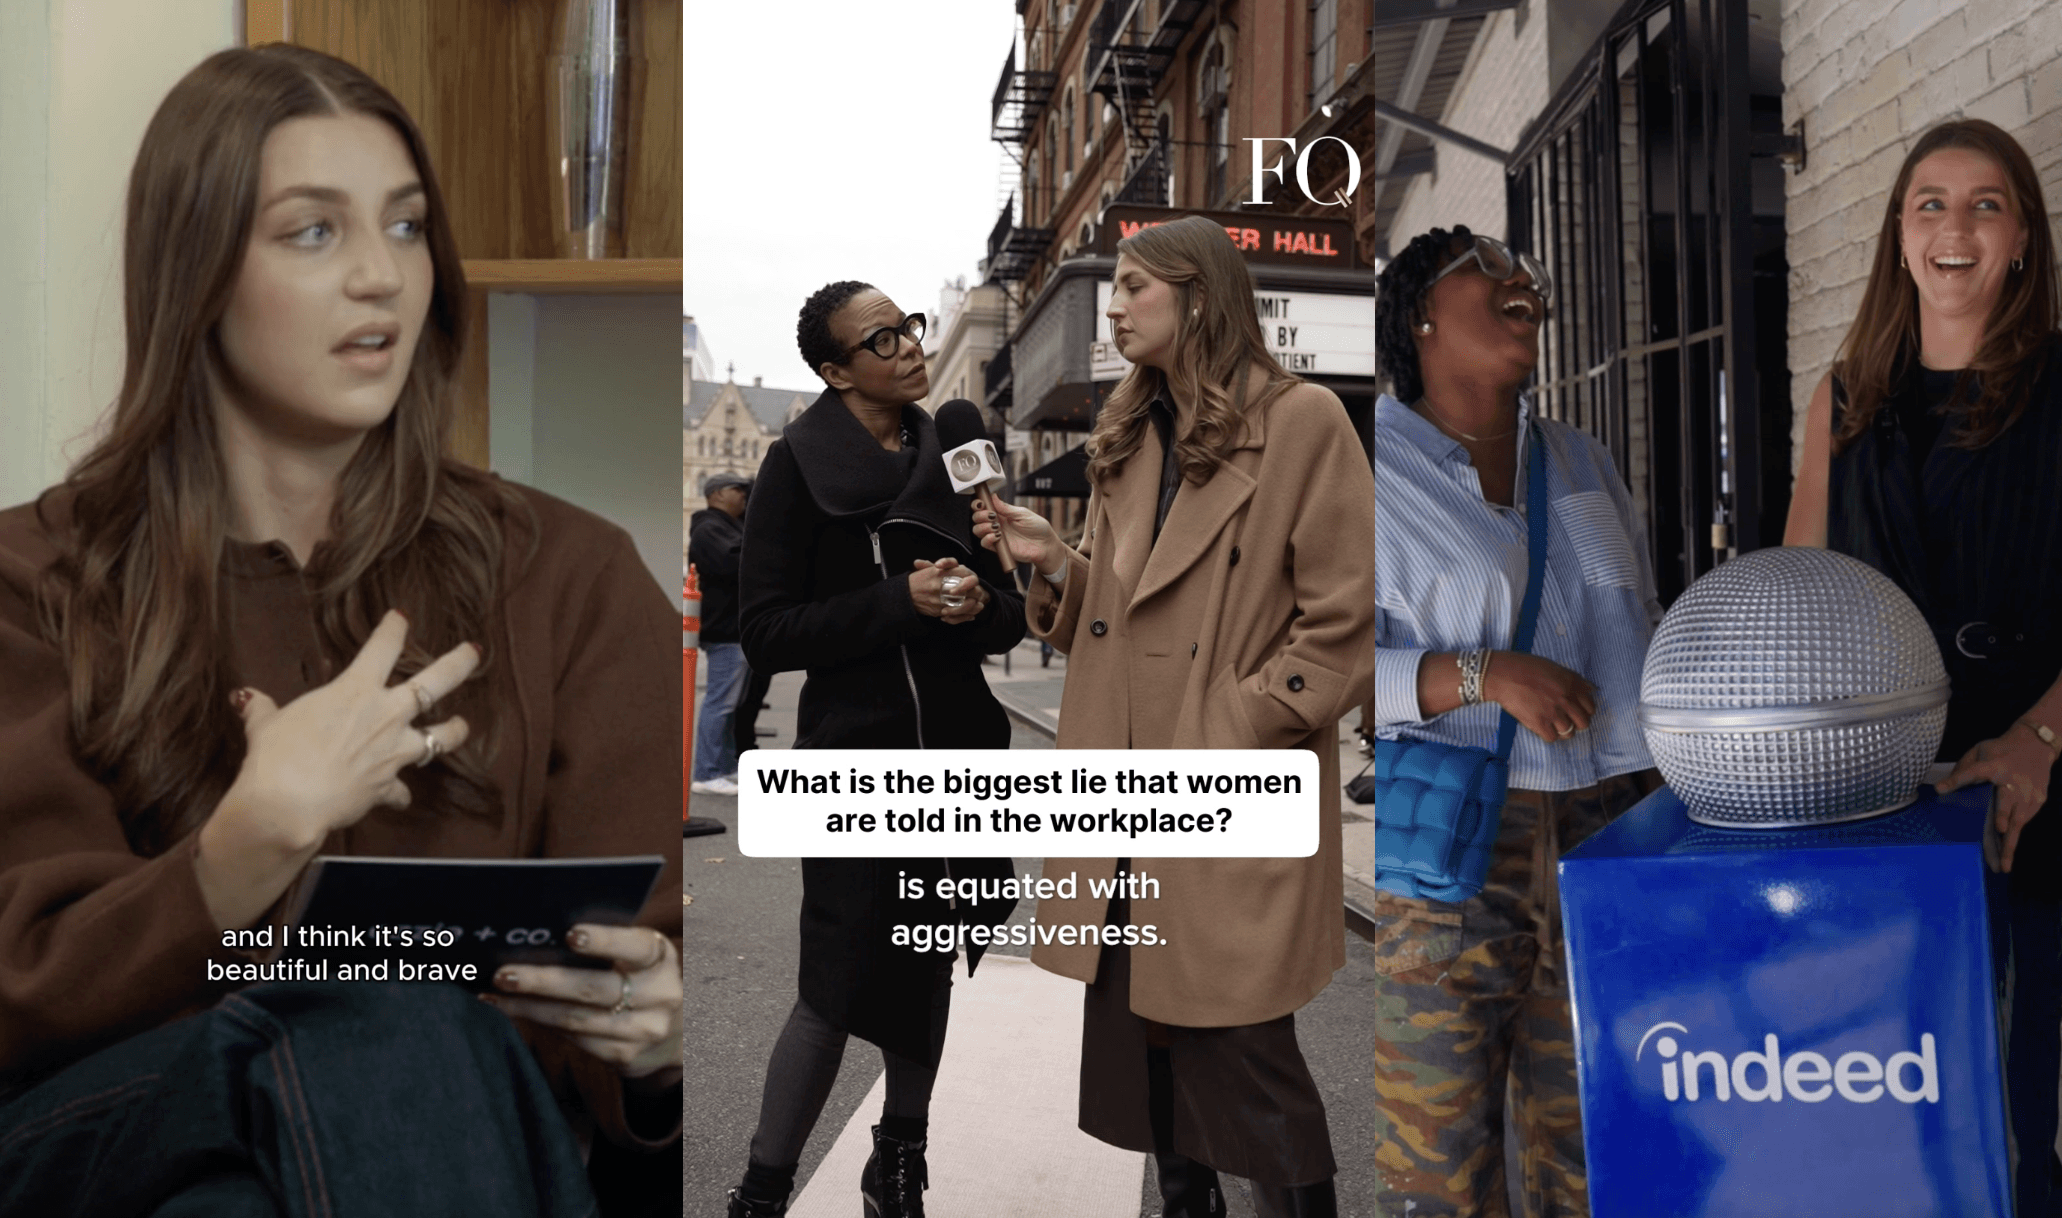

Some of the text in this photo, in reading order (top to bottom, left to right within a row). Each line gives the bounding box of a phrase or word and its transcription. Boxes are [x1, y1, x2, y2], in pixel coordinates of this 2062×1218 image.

[1274, 230, 1338, 256] HALL
[1278, 326, 1298, 347] BY
[505, 927, 557, 946] co.
[1638, 1022, 1940, 1104] indeed
